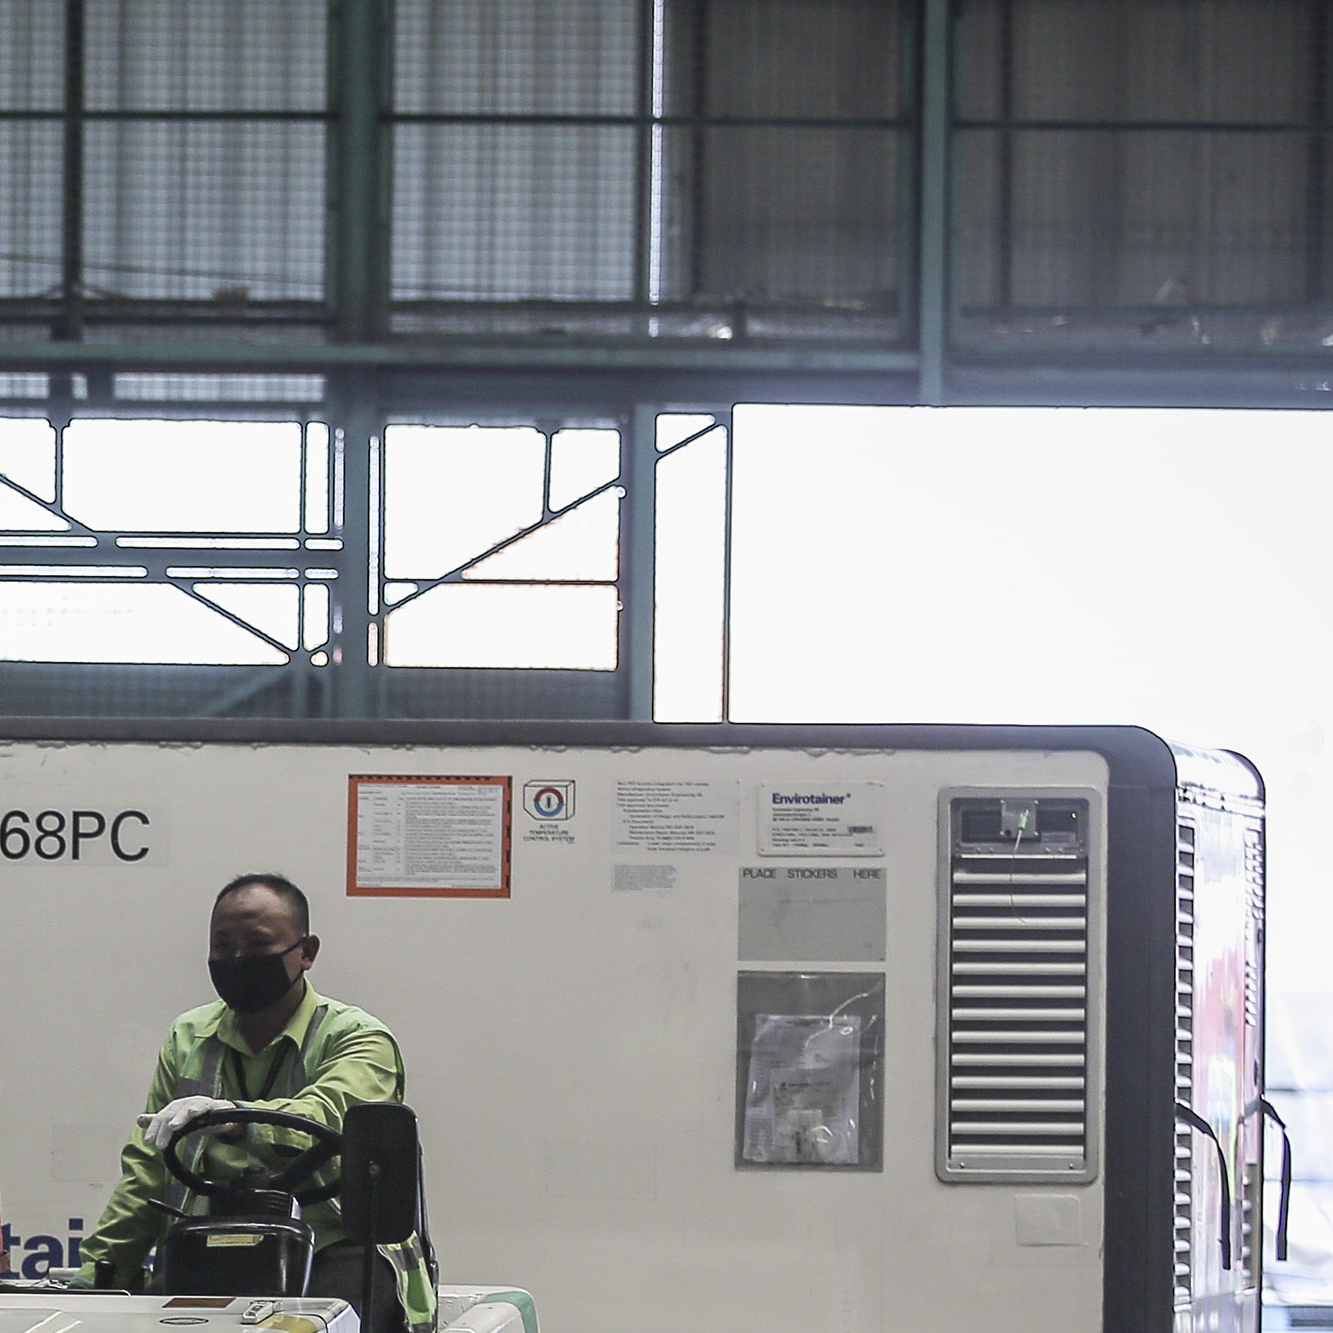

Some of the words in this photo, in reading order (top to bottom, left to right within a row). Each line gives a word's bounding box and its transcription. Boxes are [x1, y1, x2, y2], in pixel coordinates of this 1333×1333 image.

[742, 868, 776, 879] PLACE
[787, 868, 837, 879] STICKERS
[853, 868, 882, 879] HERE
